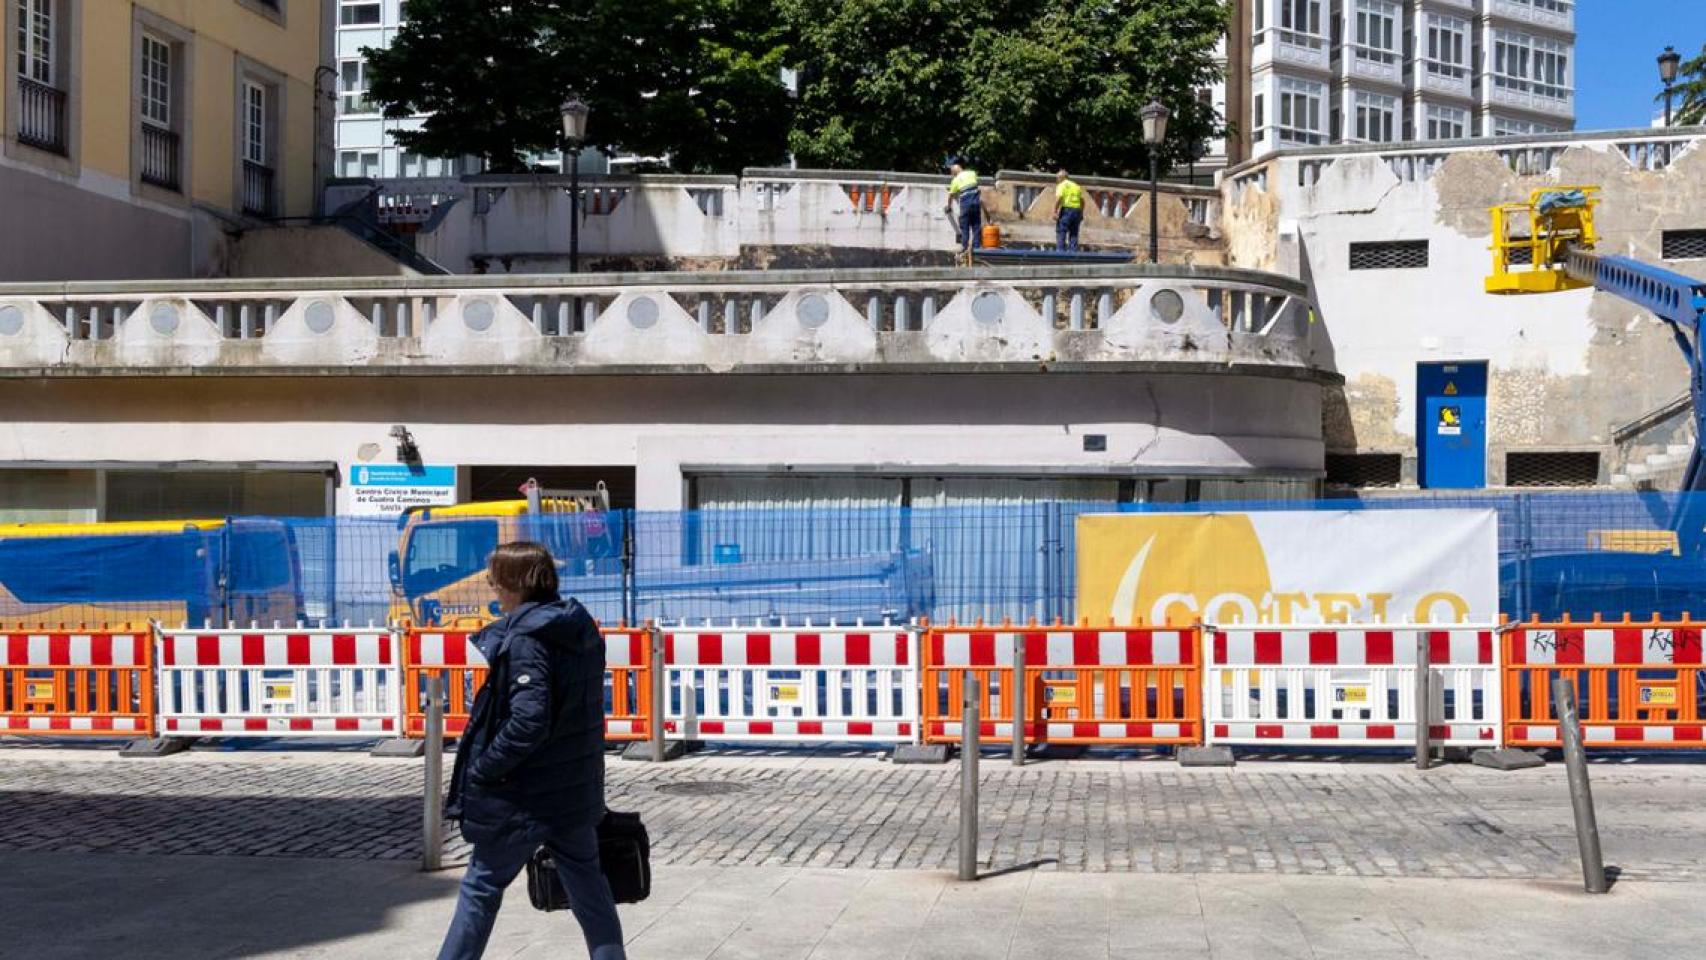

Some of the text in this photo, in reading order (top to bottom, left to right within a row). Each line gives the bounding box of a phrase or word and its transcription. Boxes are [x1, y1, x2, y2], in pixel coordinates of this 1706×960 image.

[411, 488, 448, 496] Municipal
[369, 495, 394, 503] Cuatro
[397, 495, 431, 503] Caminos
